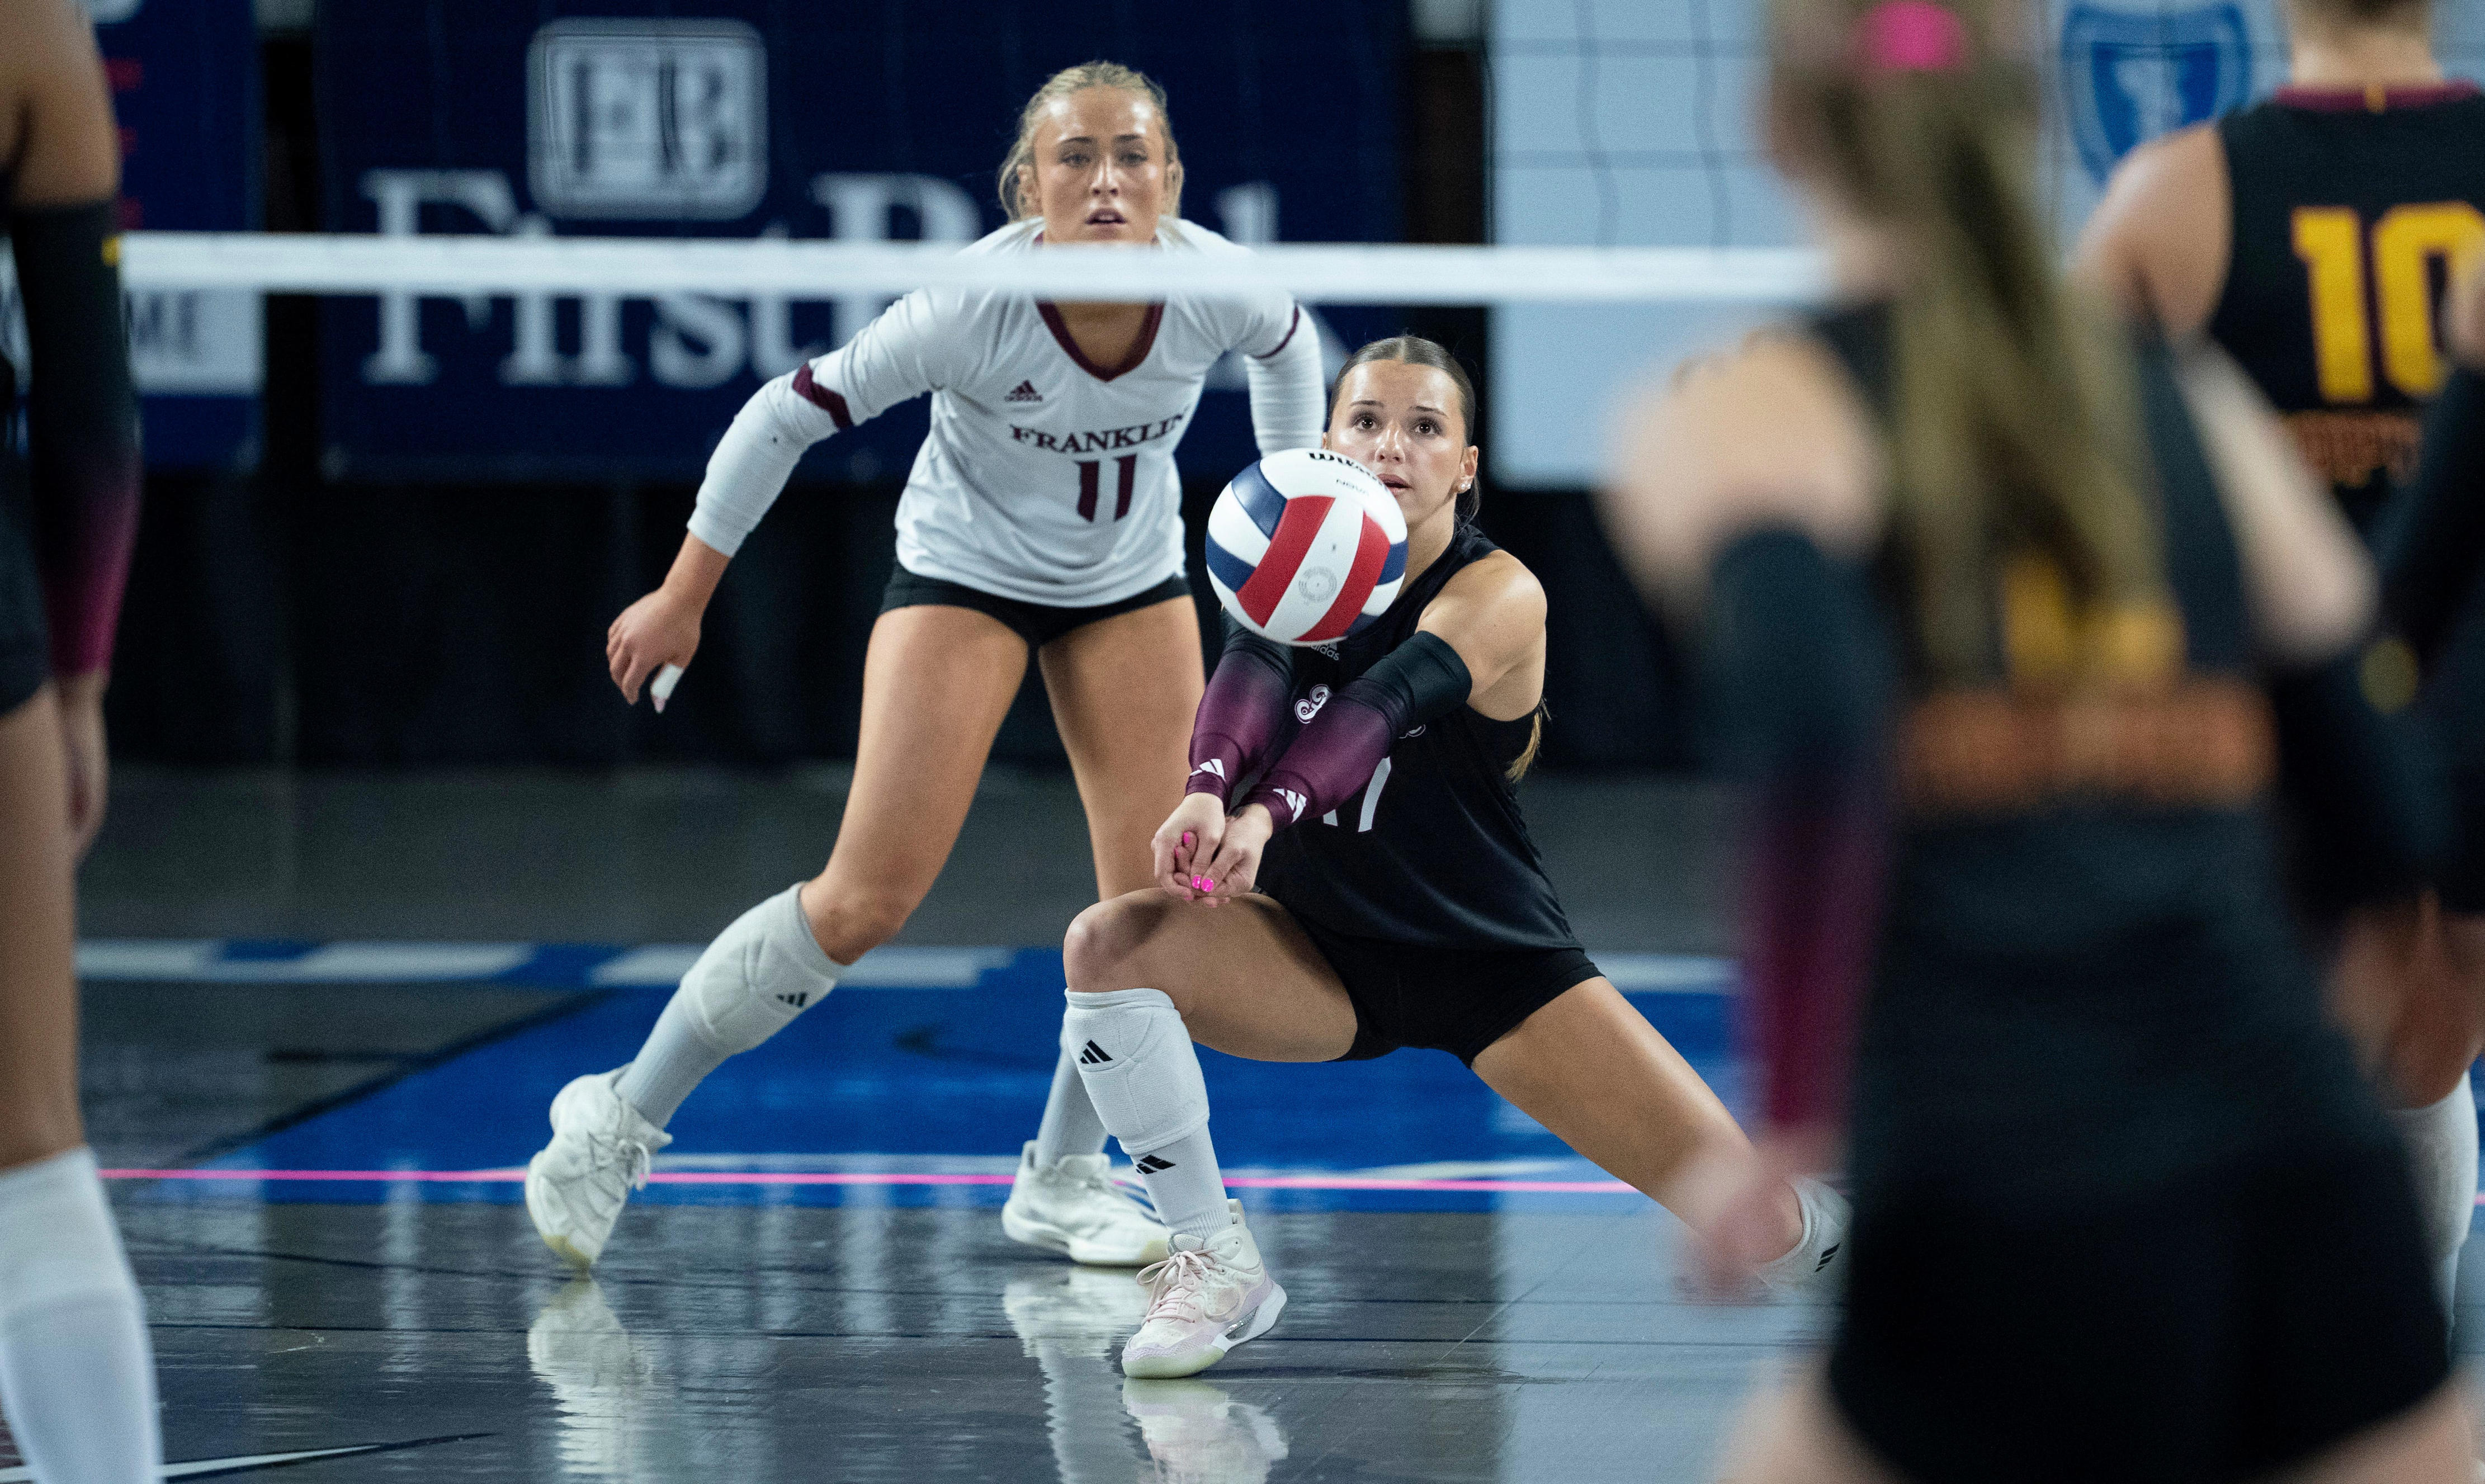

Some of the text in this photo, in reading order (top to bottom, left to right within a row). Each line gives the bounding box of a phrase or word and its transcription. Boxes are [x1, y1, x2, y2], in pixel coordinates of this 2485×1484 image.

[358, 168, 1350, 390] FirstB
[1074, 453, 1137, 522] 11
[1310, 642, 1340, 661] didas
